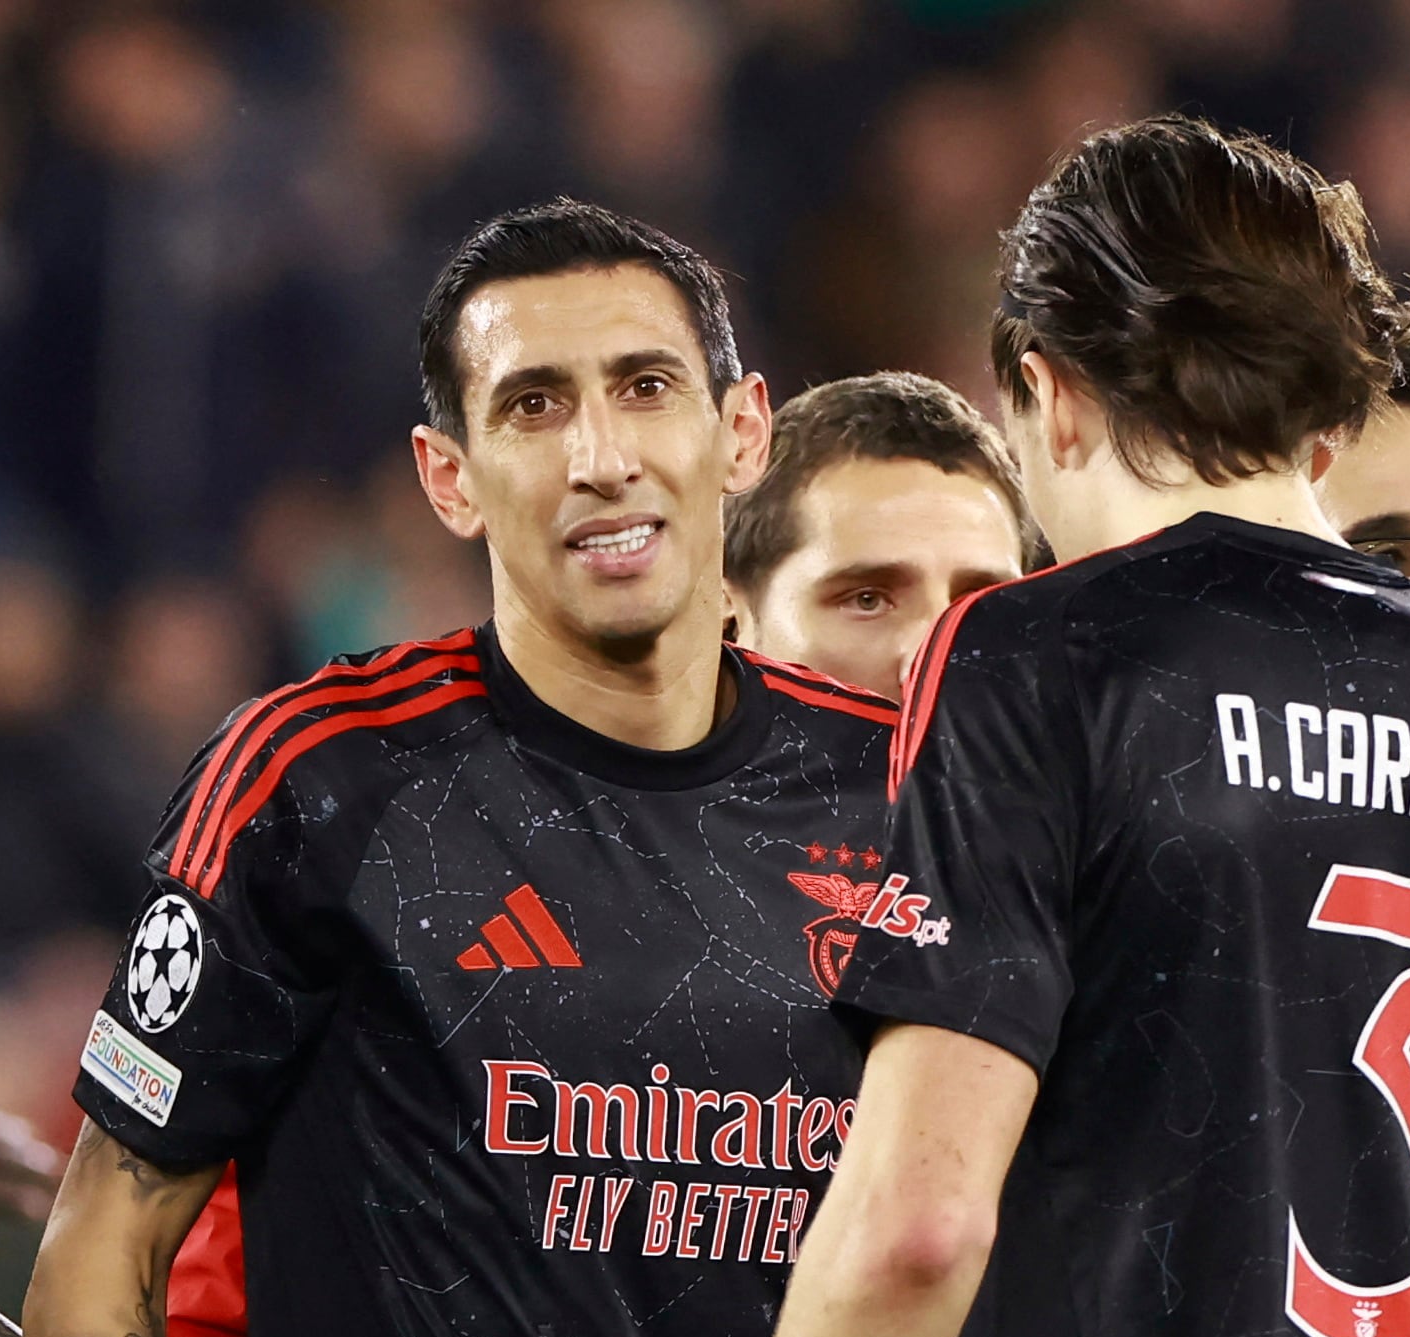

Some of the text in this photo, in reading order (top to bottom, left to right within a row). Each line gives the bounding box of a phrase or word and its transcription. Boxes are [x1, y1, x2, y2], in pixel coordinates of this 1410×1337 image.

[482, 1059, 857, 1173] Emirates
[542, 1174, 810, 1264] FLY BETTER
